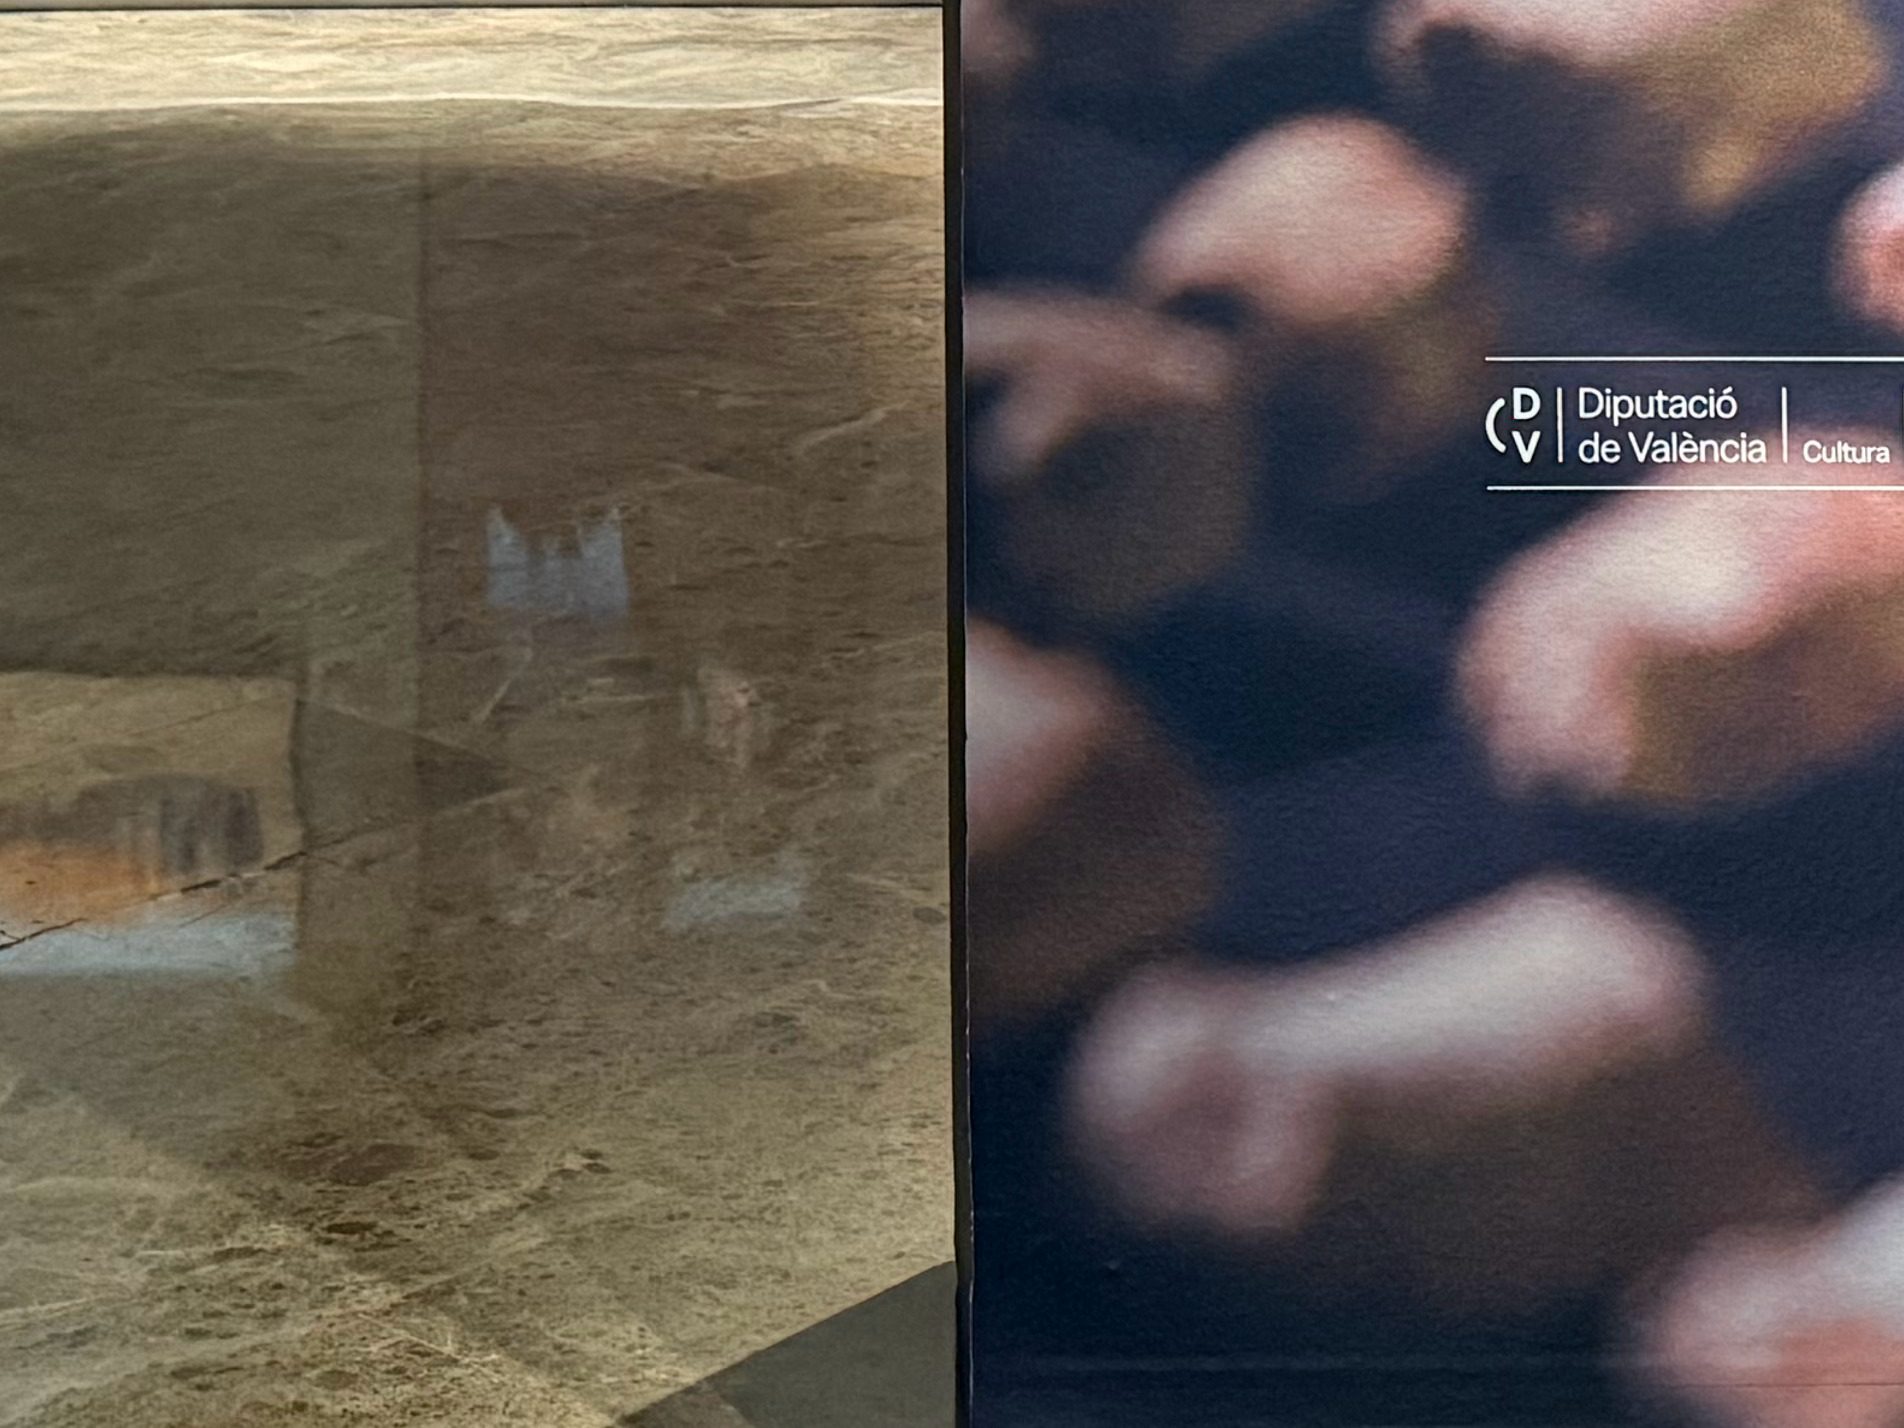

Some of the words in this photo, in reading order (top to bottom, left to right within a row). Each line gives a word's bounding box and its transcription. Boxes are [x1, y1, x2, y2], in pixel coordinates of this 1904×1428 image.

[1578, 386, 1738, 427] Diputació
[1578, 431, 1621, 464] de
[1628, 430, 1767, 464] València
[1803, 439, 1890, 464] Cultura
